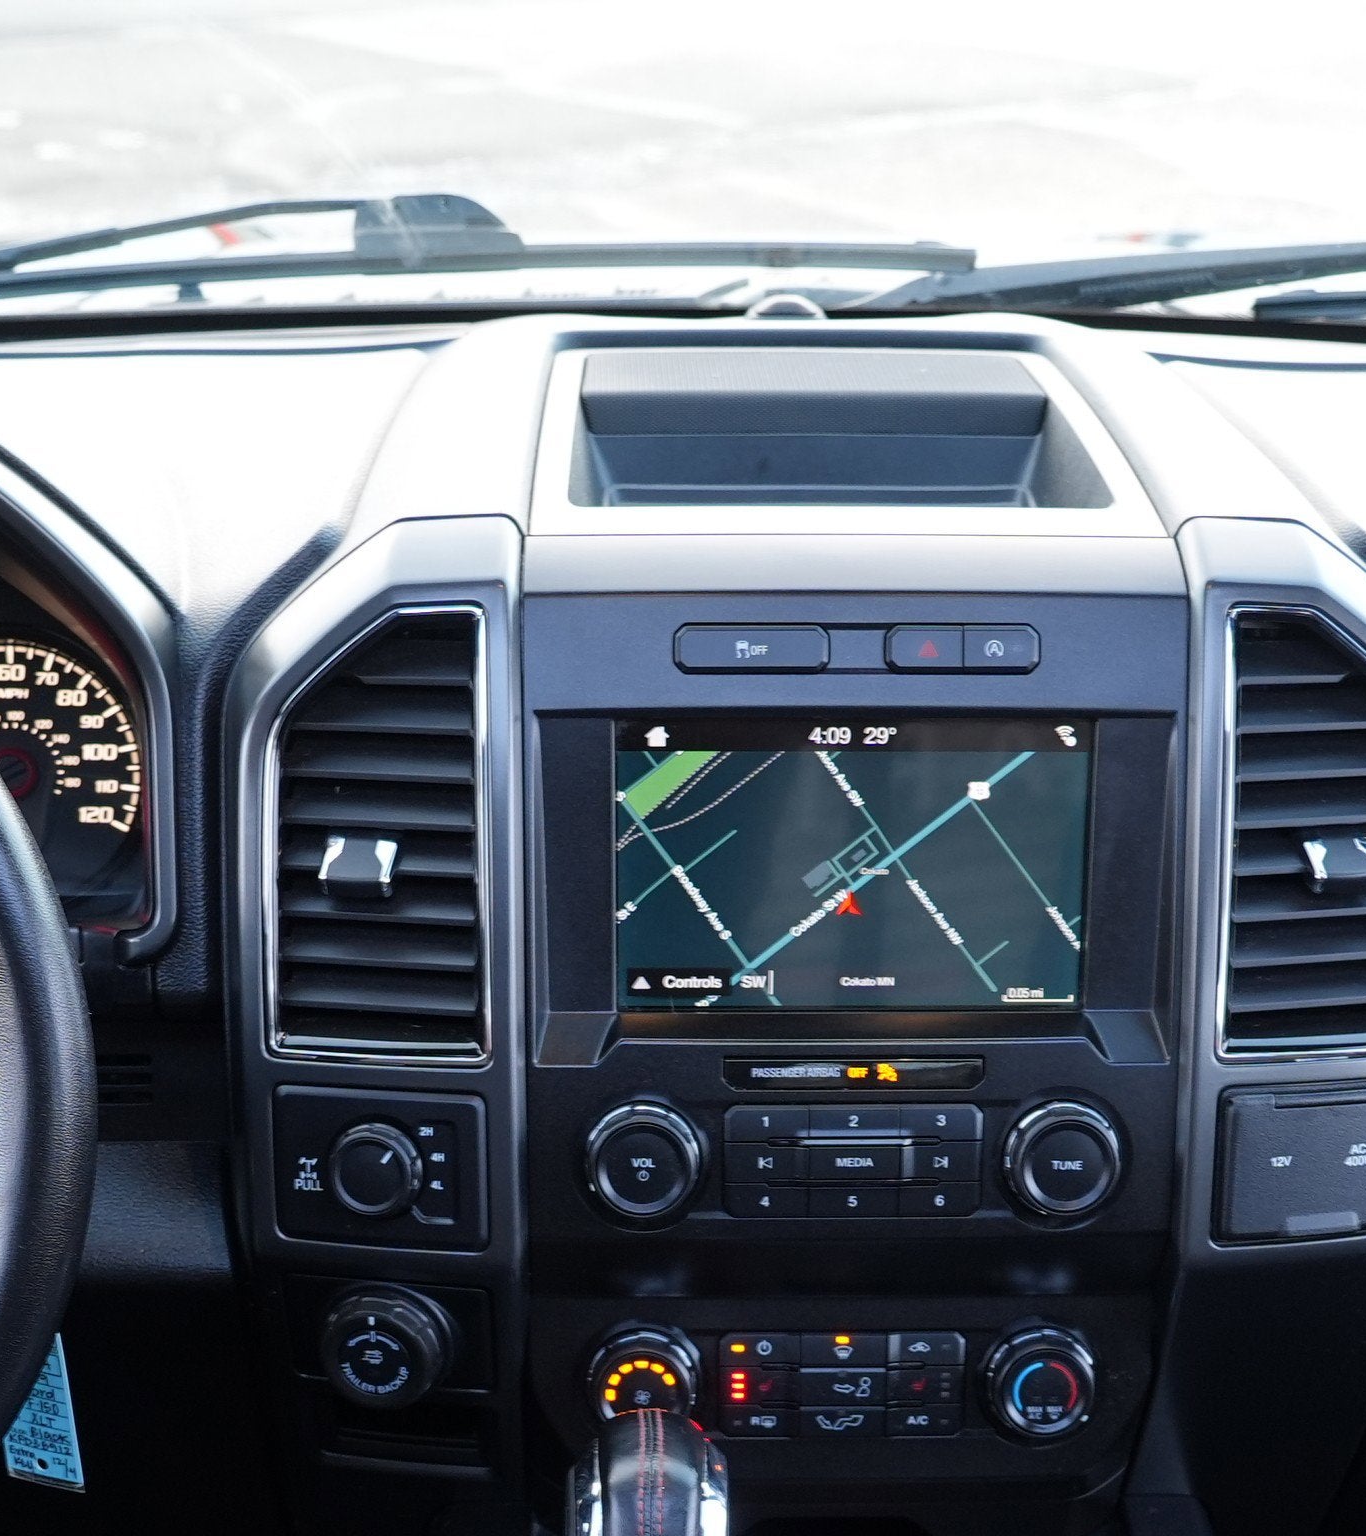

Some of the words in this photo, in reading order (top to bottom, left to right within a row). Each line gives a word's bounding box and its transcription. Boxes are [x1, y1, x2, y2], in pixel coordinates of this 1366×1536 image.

[751, 645, 768, 656] OFF
[35, 672, 59, 686] 70
[55, 689, 87, 706] 80
[79, 714, 104, 729] 90
[808, 726, 852, 745] 4:09
[862, 726, 897, 745] 29°
[81, 744, 118, 761] 100
[95, 779, 119, 793] 110
[834, 773, 851, 791] Ave
[846, 790, 865, 807] SW
[78, 806, 114, 824] 120
[671, 864, 711, 913] Broadway
[704, 911, 724, 931] Ave
[718, 930, 732, 940] S
[789, 908, 826, 937] Cokato
[822, 899, 838, 911] St
[905, 879, 937, 915] Jackson
[933, 912, 950, 931] Ave
[945, 927, 964, 945] NW
[1045, 906, 1077, 942] Johnson
[662, 975, 723, 989] Controls
[739, 975, 767, 989] SW
[840, 977, 876, 986] Cokato
[876, 977, 895, 986] MN
[1006, 987, 1030, 998] 0.05
[1031, 987, 1044, 998] mi
[751, 1067, 806, 1078] PASSENGER
[807, 1067, 841, 1078] AIRBAG
[847, 1067, 869, 1078] OFF
[761, 1116, 769, 1127] 1
[848, 1116, 858, 1127] 2
[935, 1115, 946, 1126] 3
[418, 1127, 433, 1136] 2H
[1349, 1143, 1366, 1155] AC
[430, 1153, 445, 1162] 4H
[631, 1157, 655, 1169] VOL
[836, 1157, 874, 1168] MEDIA
[1270, 1156, 1292, 1167] 12V
[1051, 1160, 1083, 1171] TUNE
[294, 1179, 323, 1191] PULL
[430, 1181, 444, 1190] 4L
[759, 1196, 769, 1207] 4
[847, 1196, 858, 1207] 5
[935, 1195, 945, 1206] 6
[340, 1362, 375, 1393] TRAILER
[377, 1366, 409, 1394] BACKUP
[31, 1388, 55, 1400] ord
[906, 1416, 929, 1425] A/C
